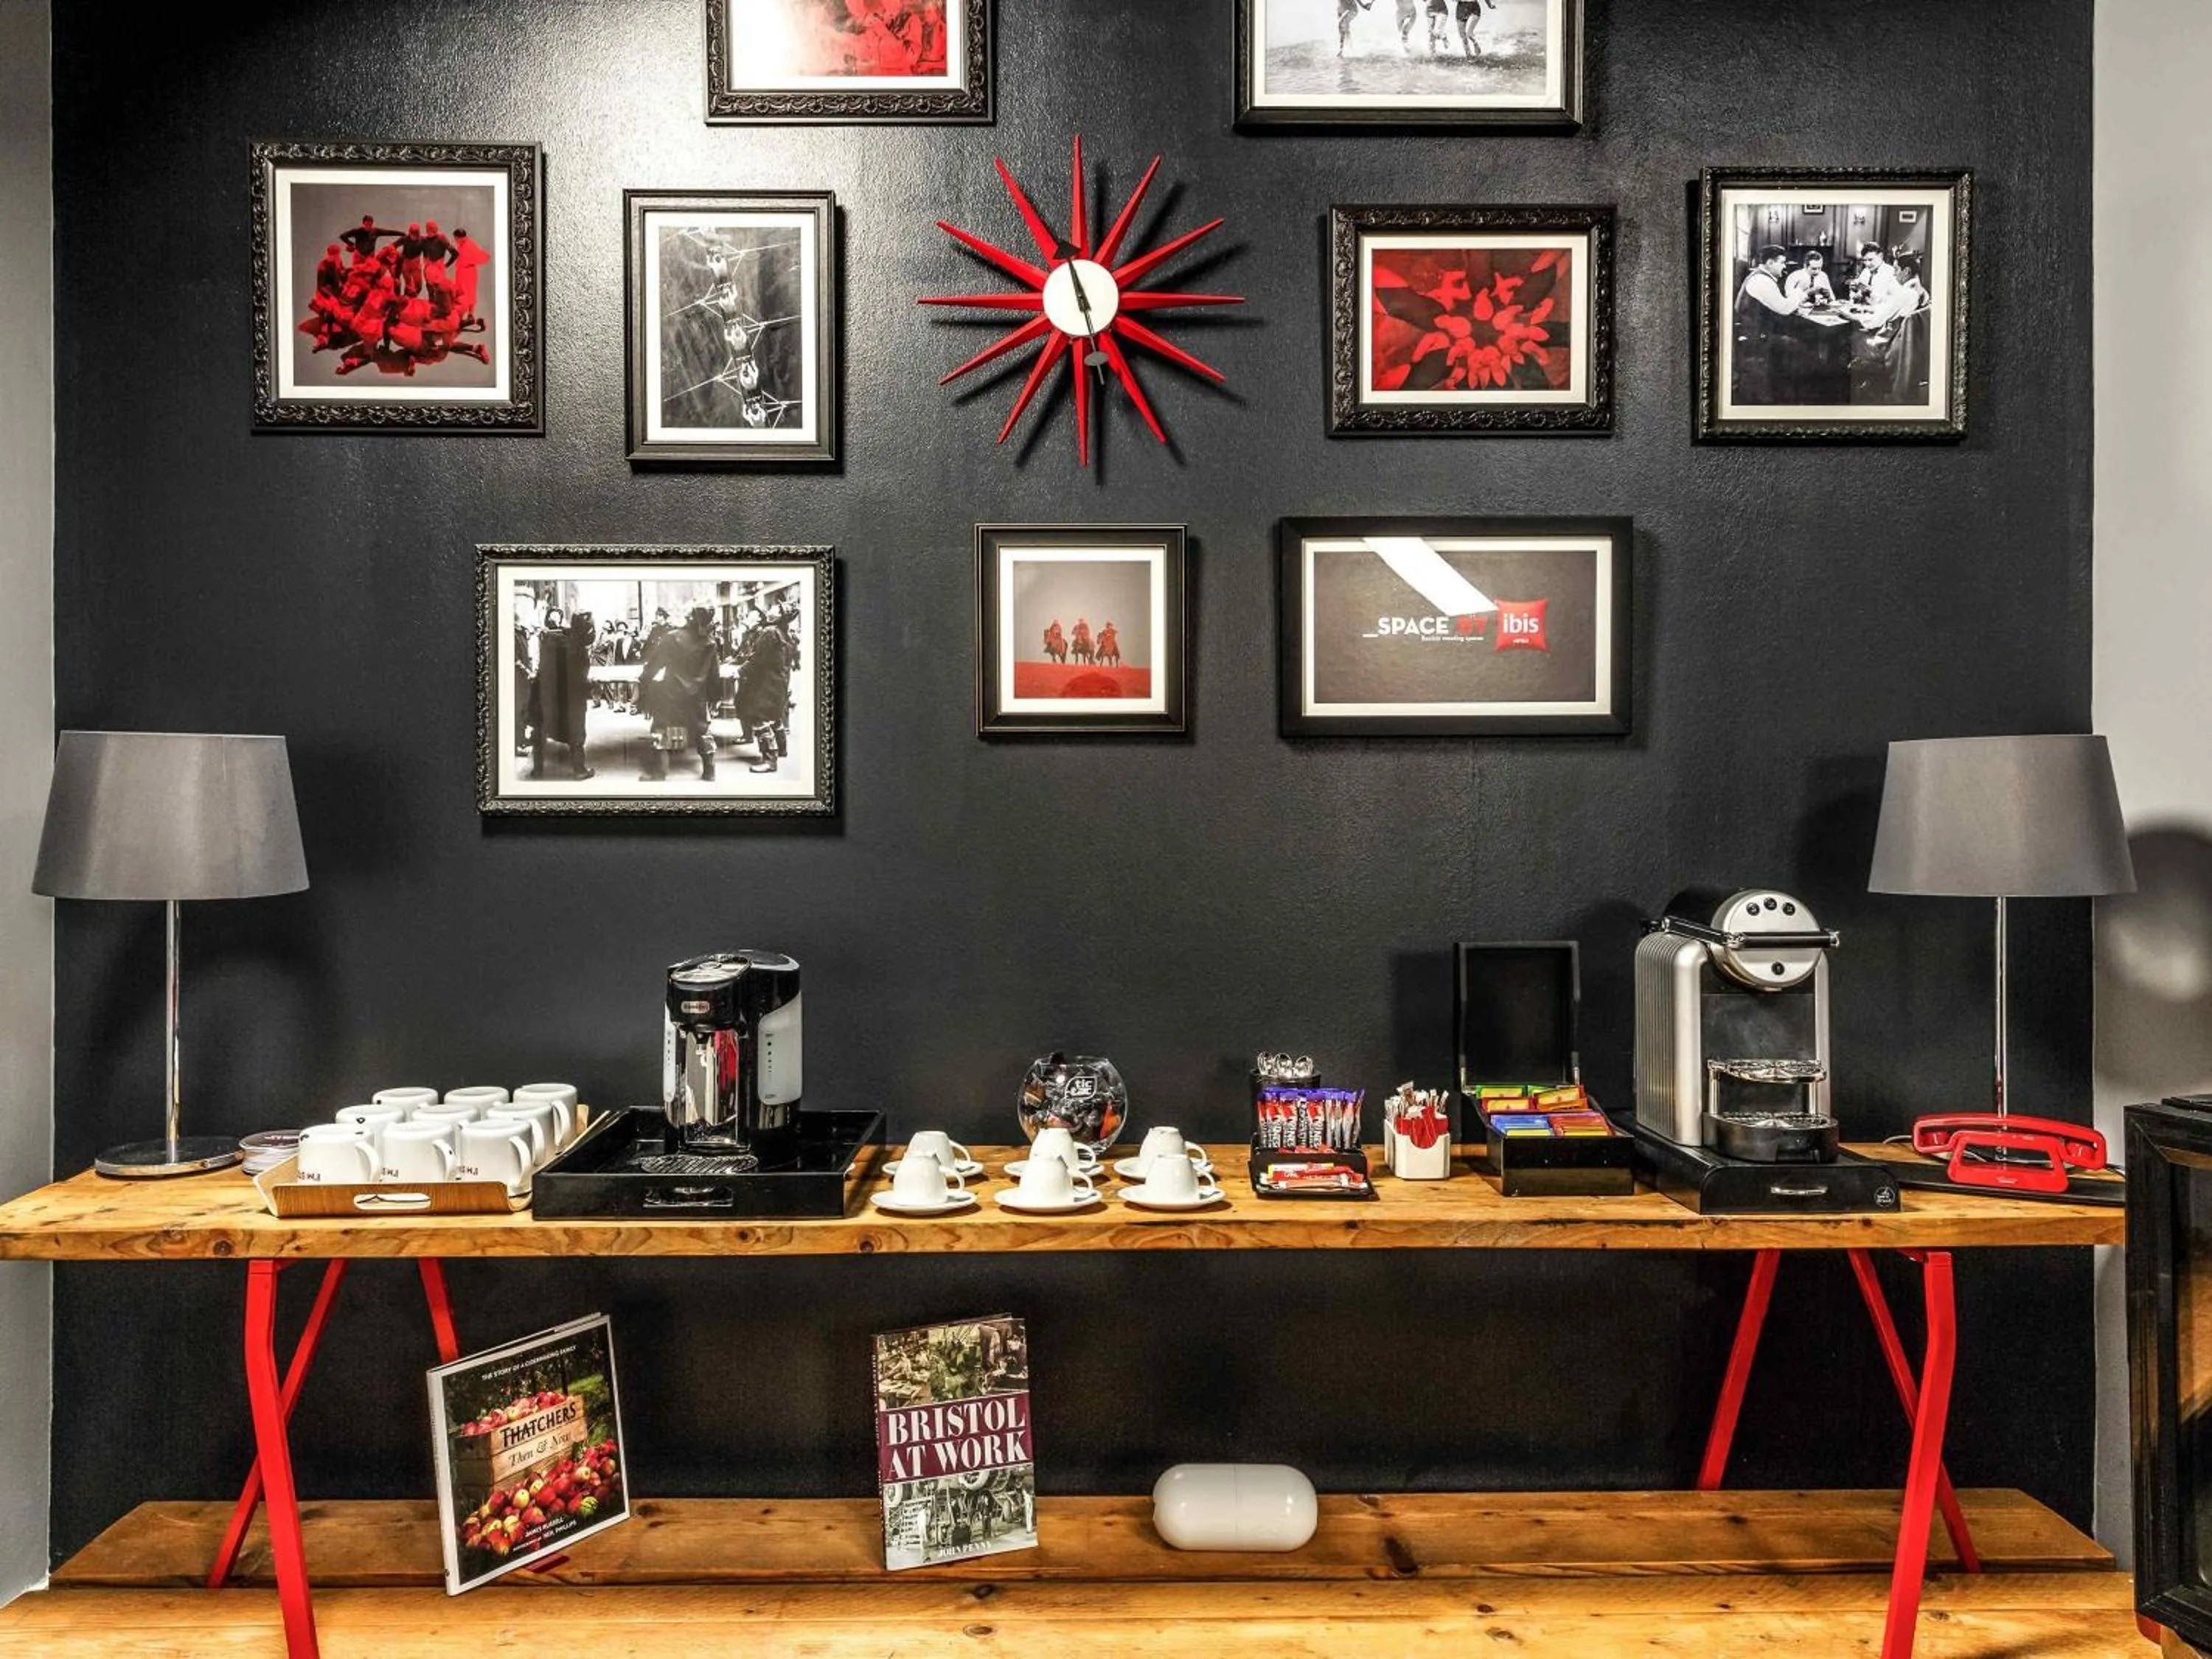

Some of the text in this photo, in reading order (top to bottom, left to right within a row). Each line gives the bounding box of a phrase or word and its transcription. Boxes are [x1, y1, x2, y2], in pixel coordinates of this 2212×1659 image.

[1503, 613, 1539, 633] ibis
[1071, 1088, 1092, 1096] tac
[1075, 1079, 1093, 1088] tic
[500, 1402, 576, 1447] THATCHERS
[887, 1397, 1026, 1445] BRISTOL
[509, 1433, 571, 1467] Then & Now
[887, 1430, 1028, 1481] AT WORK
[937, 1545, 961, 1558] JOHN
